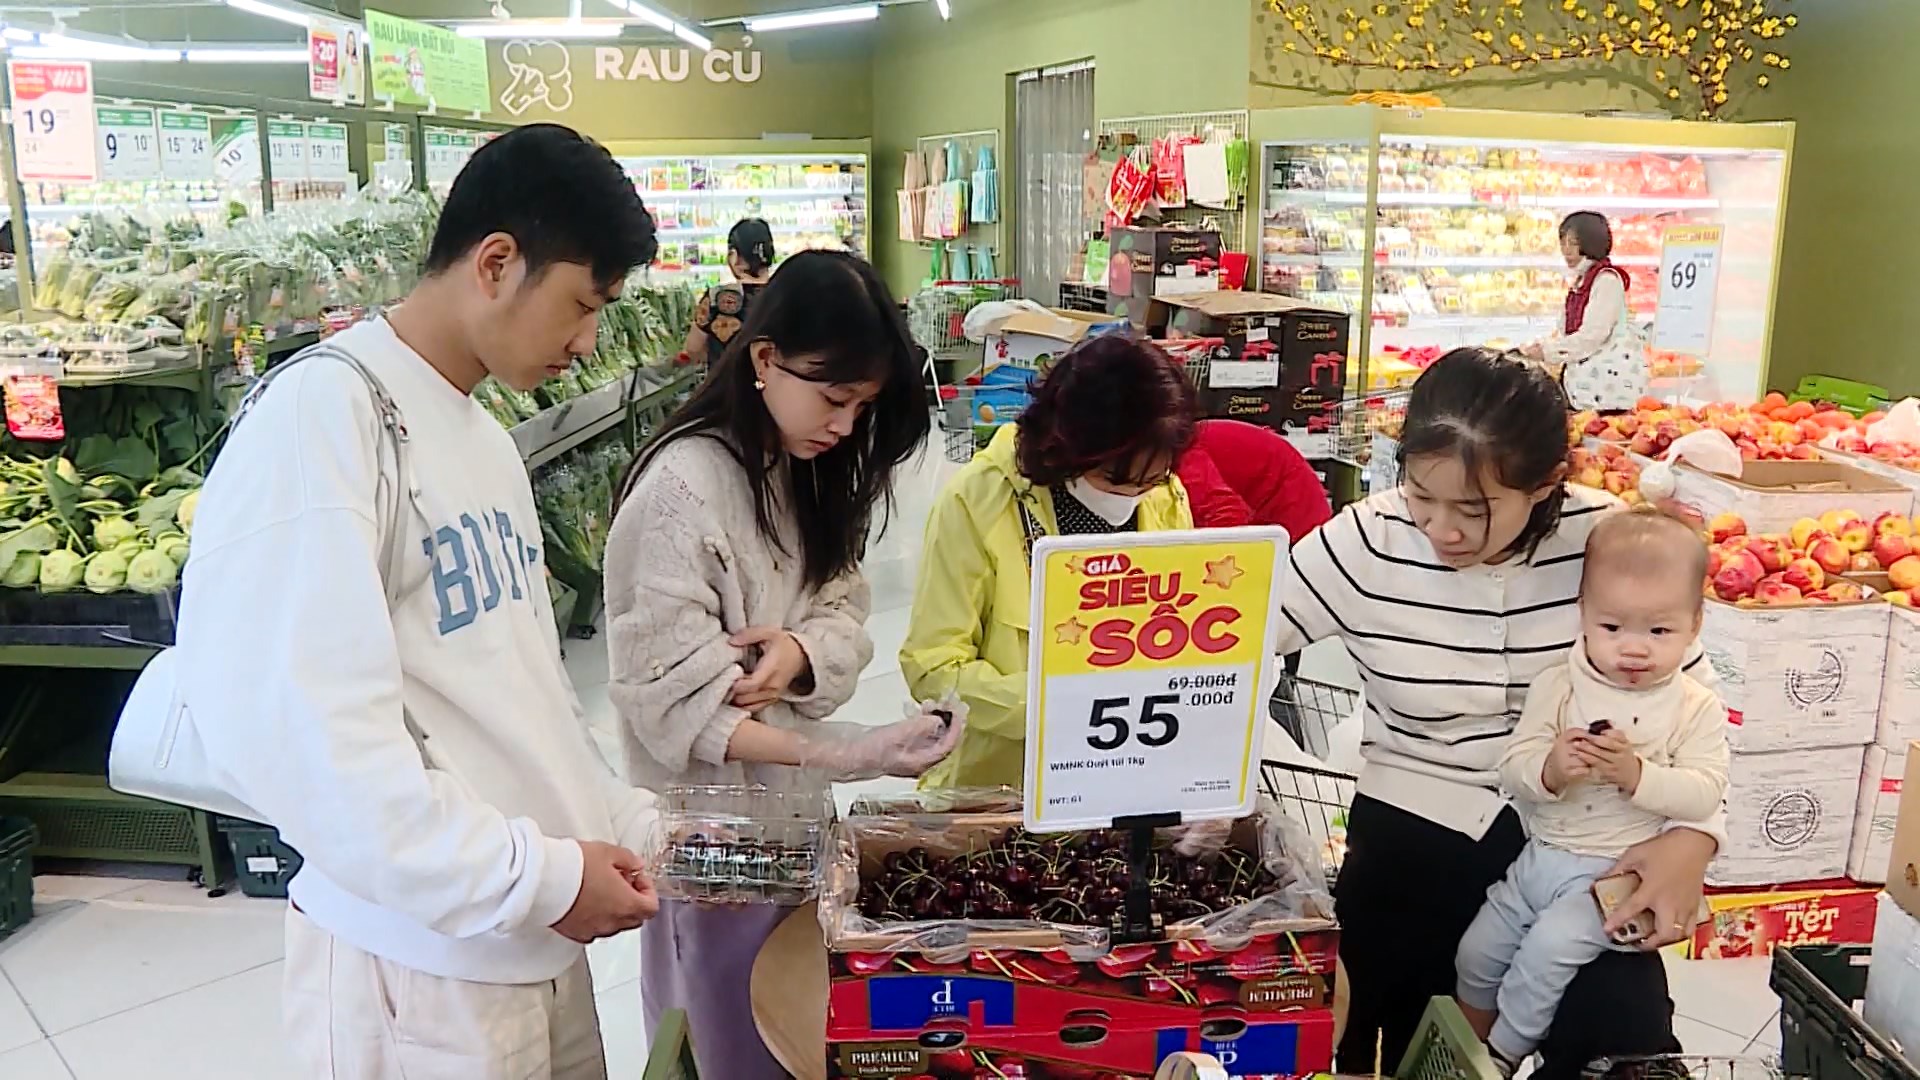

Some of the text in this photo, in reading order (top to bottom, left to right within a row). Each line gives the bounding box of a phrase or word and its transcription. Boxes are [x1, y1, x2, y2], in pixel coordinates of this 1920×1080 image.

[595, 35, 762, 82] RAU CỦ
[23, 109, 55, 134] 19
[106, 133, 117, 159] 9
[1671, 261, 1697, 290] 69
[1229, 405, 1264, 415] CANDY
[1231, 395, 1264, 405] SWEET
[1087, 554, 1123, 575] GIÁ
[1078, 567, 1181, 610] SIÊU
[1086, 593, 1242, 668] SỐC
[1168, 672, 1237, 690] 69.000đ
[1086, 693, 1180, 751] 55
[1050, 761, 1084, 772] WMNK
[1127, 756, 1145, 766] 1kg
[1785, 899, 1840, 934] TẾT
[1250, 987, 1313, 1002] PREMIUM
[852, 1051, 919, 1064] PREMIUM
